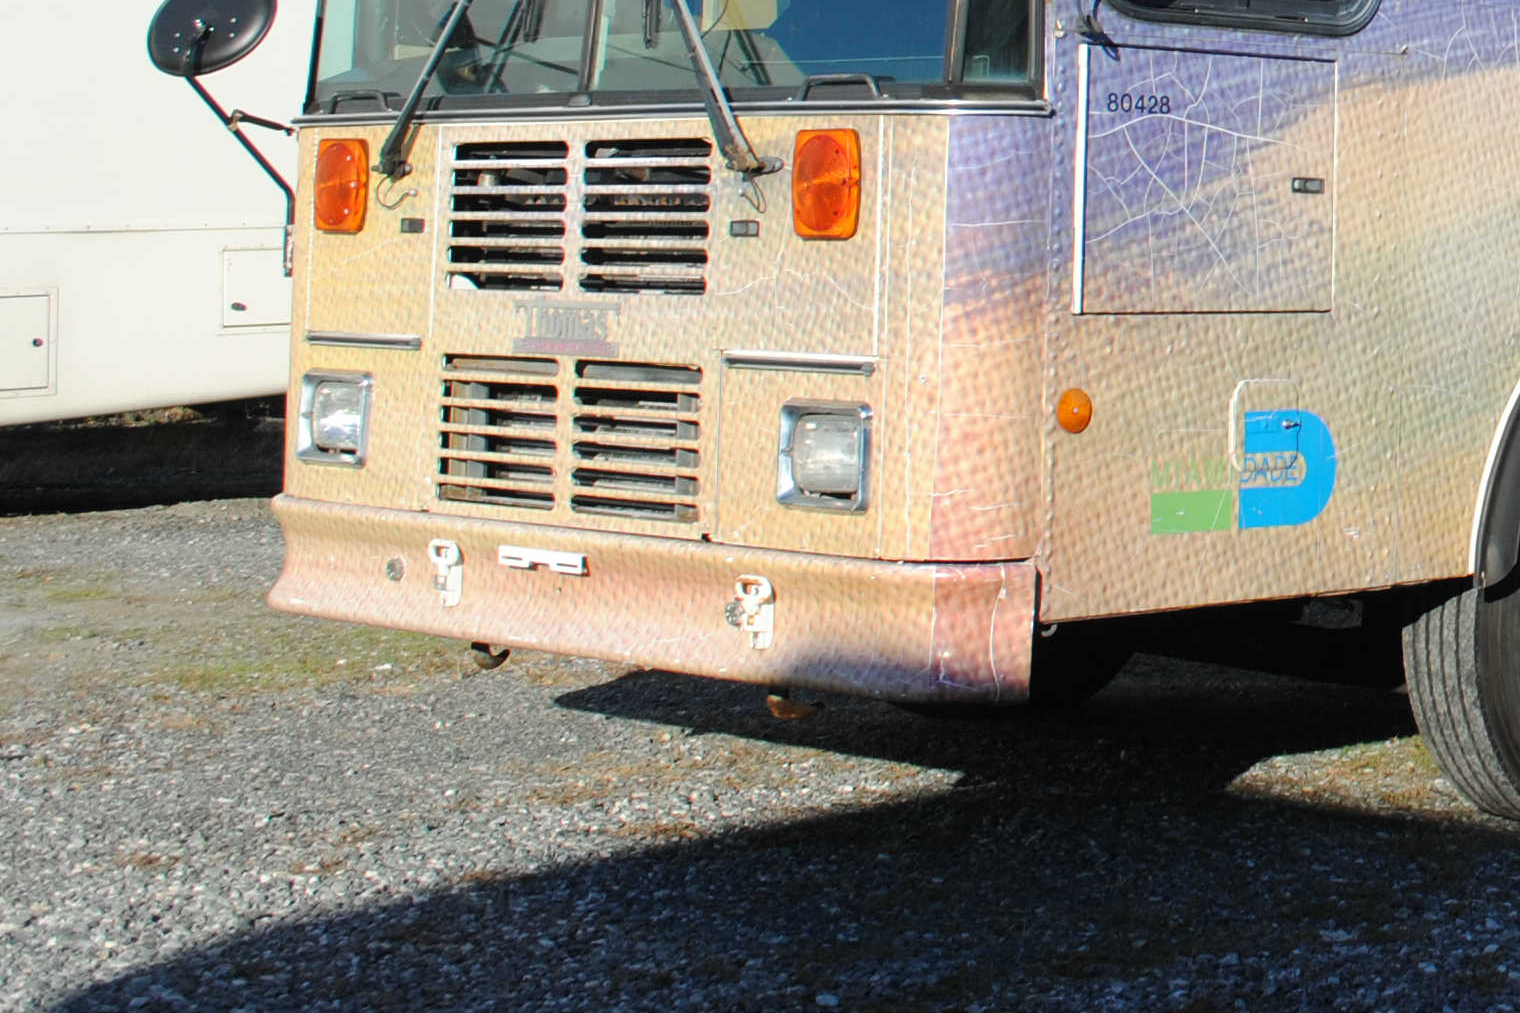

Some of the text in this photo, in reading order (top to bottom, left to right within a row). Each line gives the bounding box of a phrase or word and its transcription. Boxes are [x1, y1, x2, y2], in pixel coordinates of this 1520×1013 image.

[1107, 92, 1171, 115] 80428
[1152, 454, 1299, 487] MIAMI DADE
